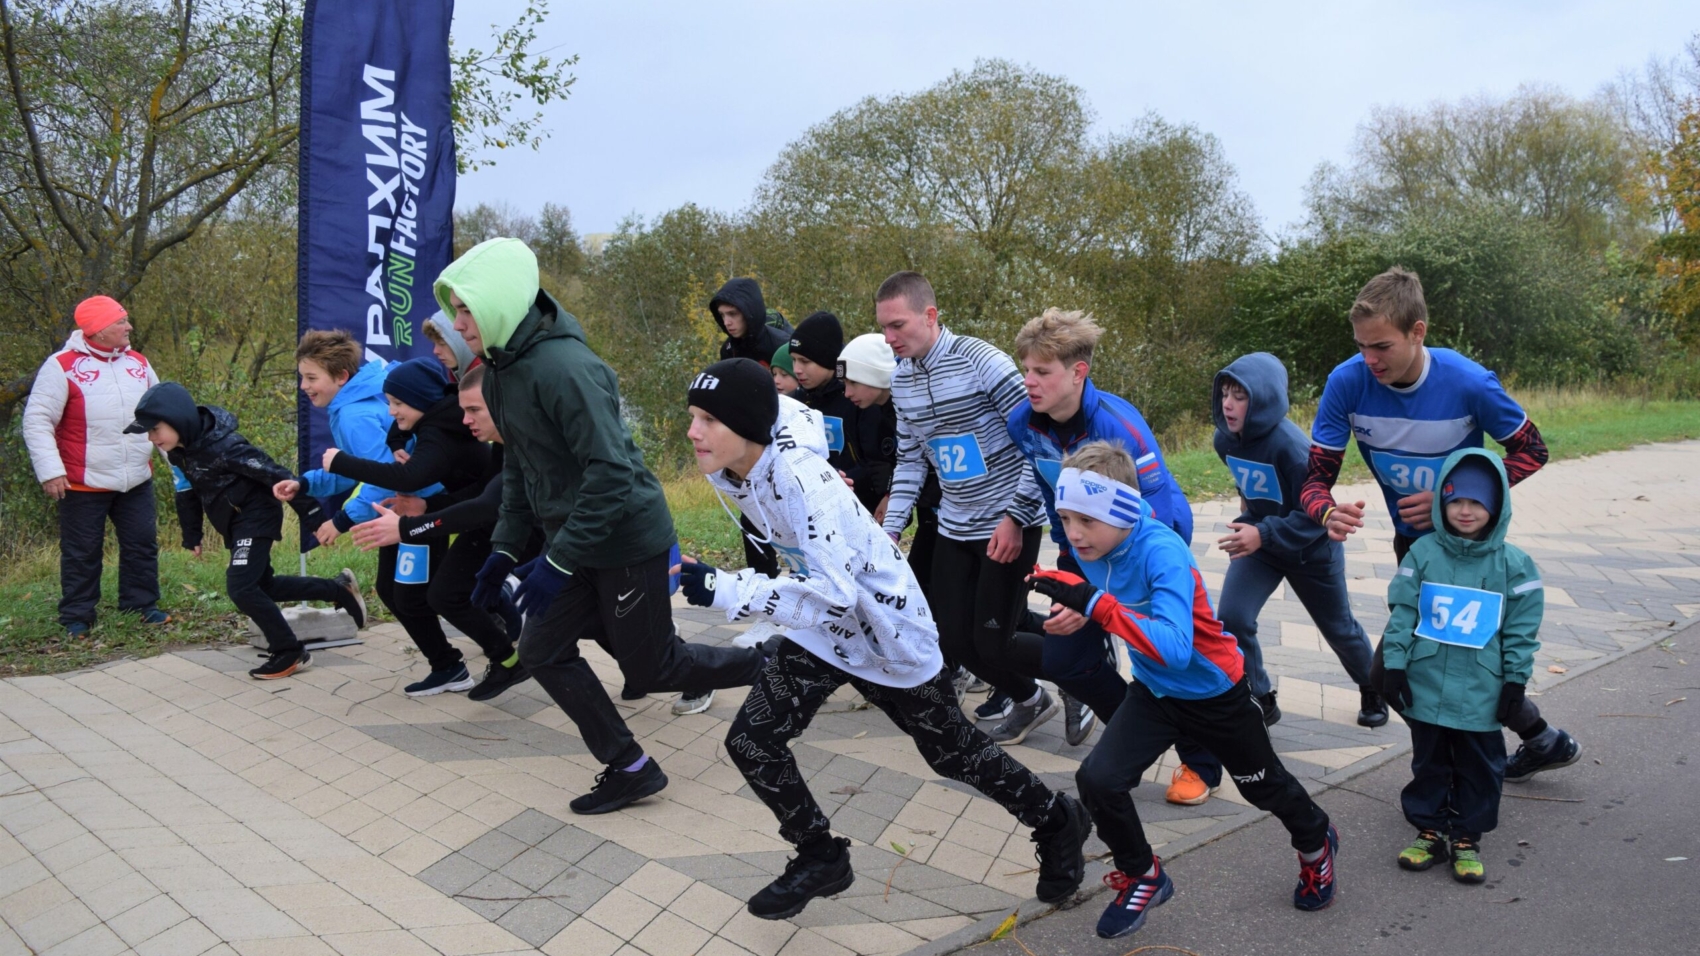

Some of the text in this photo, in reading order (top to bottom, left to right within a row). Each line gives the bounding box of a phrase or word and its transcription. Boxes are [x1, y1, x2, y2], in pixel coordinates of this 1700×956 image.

[938, 444, 968, 473] 52
[819, 470, 835, 484] AIR
[1237, 466, 1269, 493] 72
[1390, 463, 1435, 492] 30
[762, 589, 781, 616] AIR
[1431, 595, 1482, 635] 54
[829, 622, 856, 640] AIR
